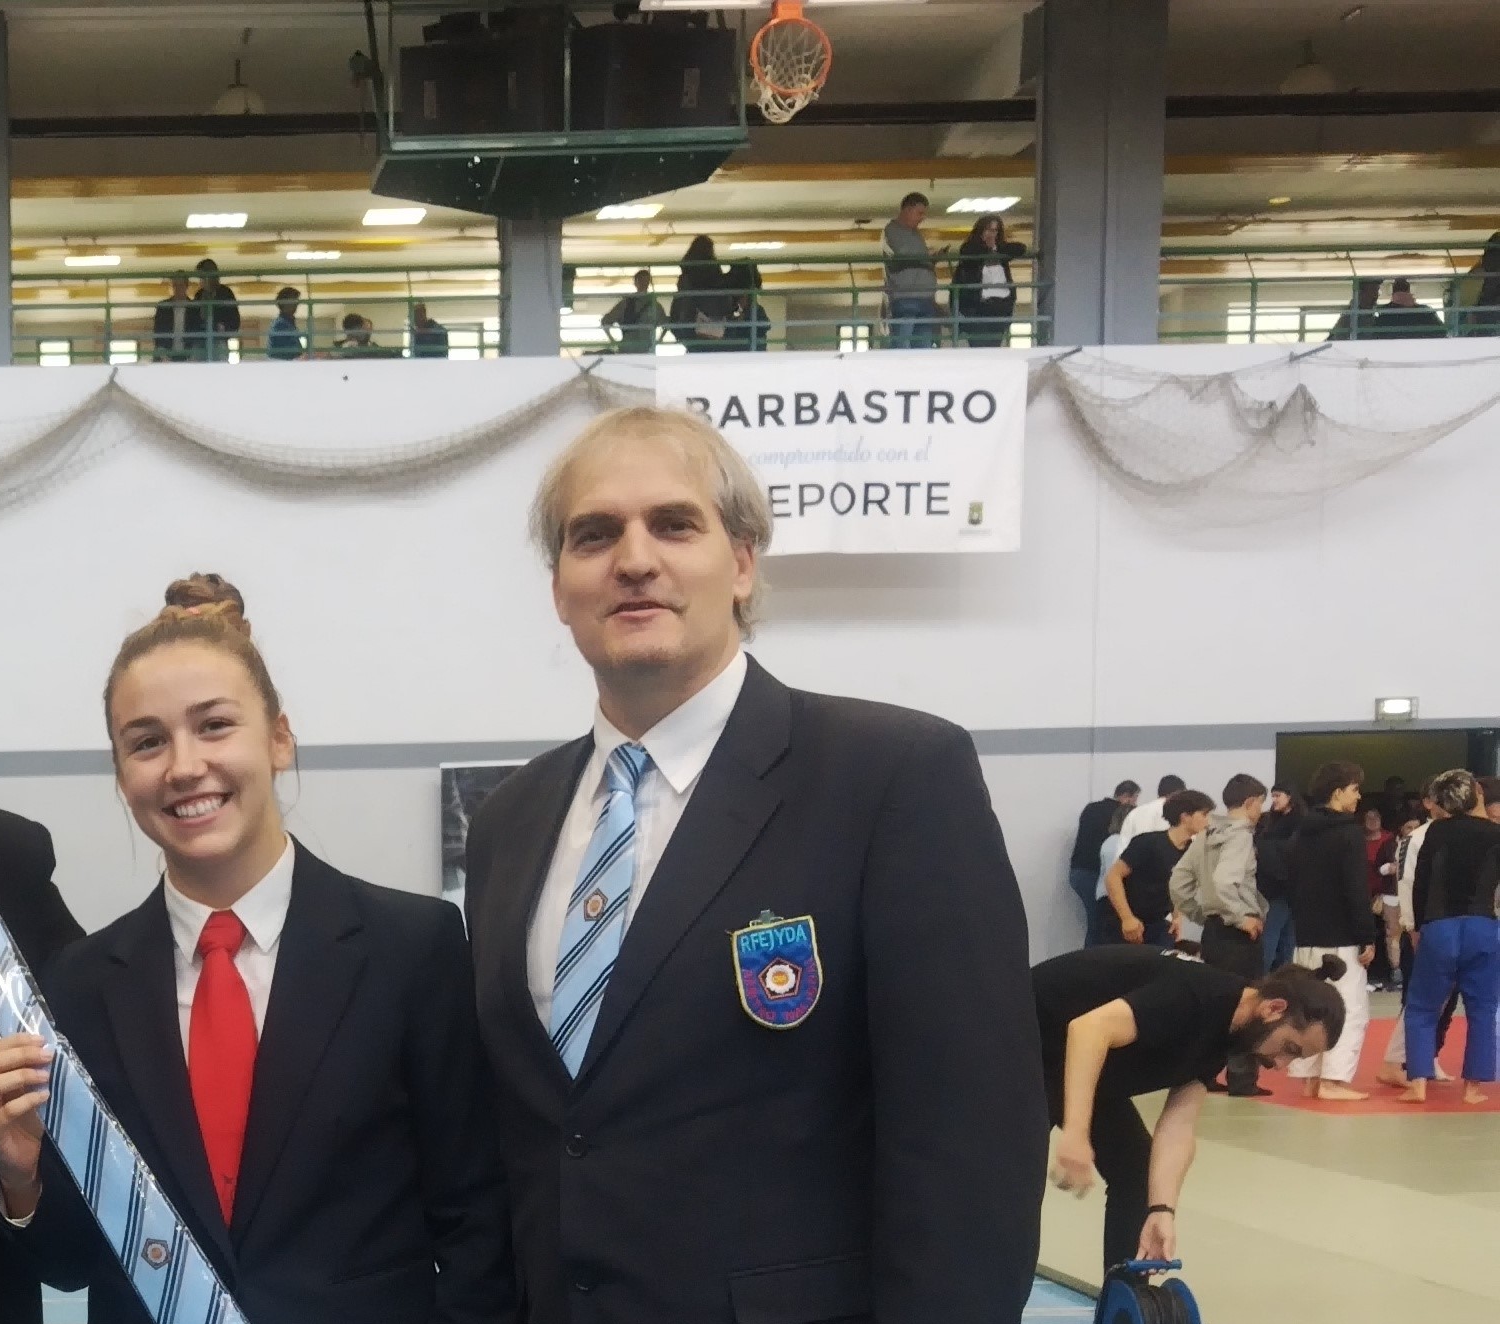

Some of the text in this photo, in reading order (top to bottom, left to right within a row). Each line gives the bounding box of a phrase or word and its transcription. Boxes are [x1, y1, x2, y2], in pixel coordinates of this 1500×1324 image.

[686, 389, 998, 428] BARBASTRO
[767, 481, 951, 519] EPORTE
[740, 925, 807, 953] RFEJYDA
